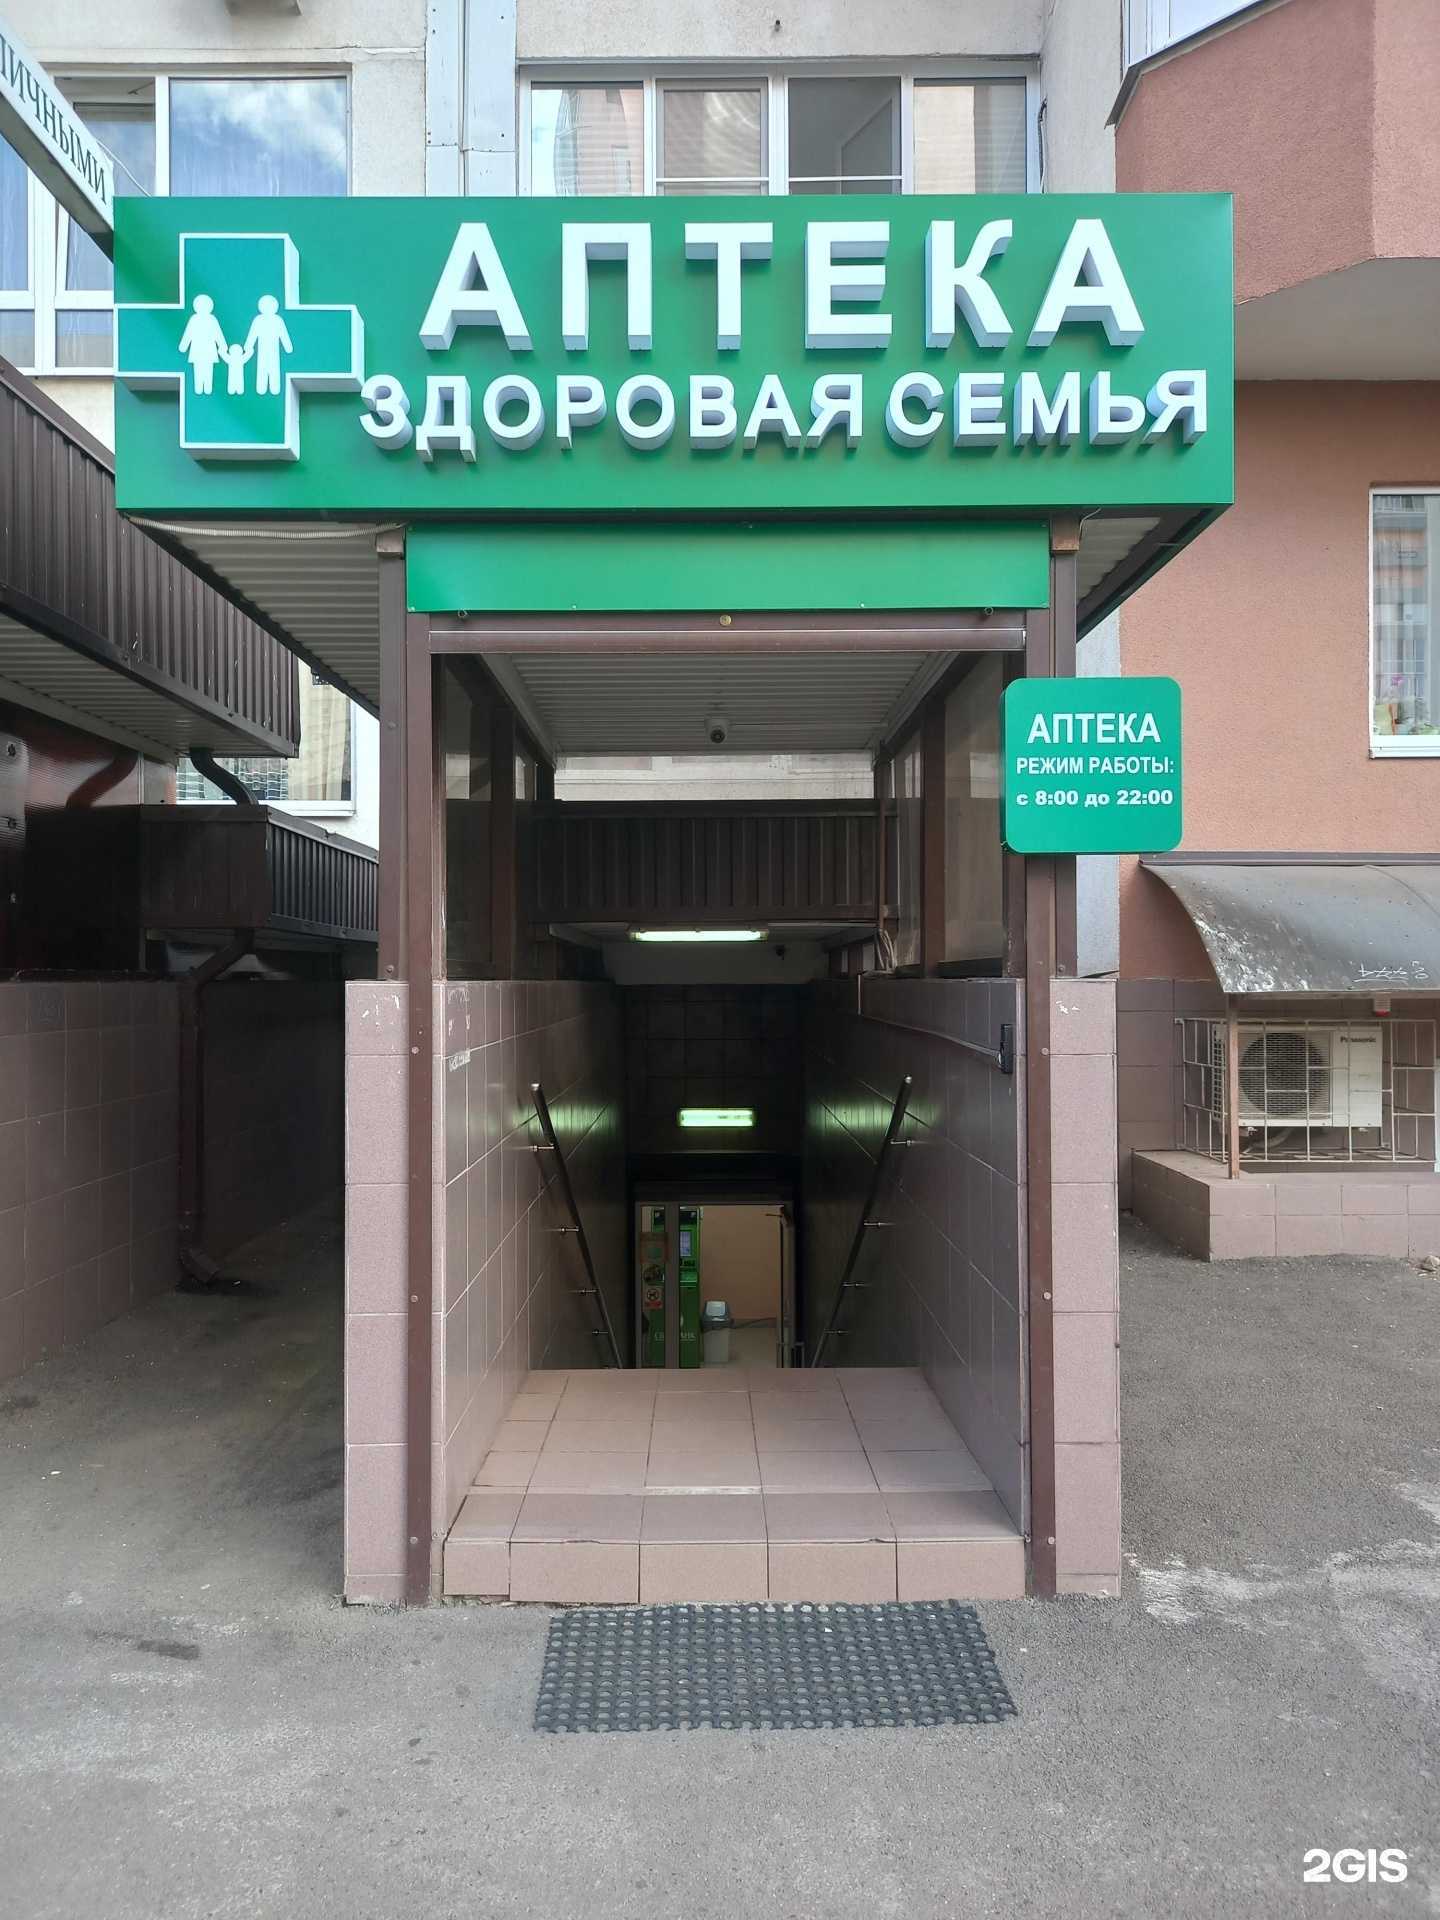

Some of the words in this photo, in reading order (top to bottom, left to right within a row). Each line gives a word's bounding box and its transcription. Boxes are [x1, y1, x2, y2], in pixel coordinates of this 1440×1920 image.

[419, 218, 1145, 351] АПТЕКА
[359, 374, 863, 462] ЗДОРОВАЯ
[886, 369, 1207, 448] СЕМЬЯ
[1027, 712, 1161, 744] АПТЕКА
[1016, 757, 1083, 775] РЕЖИМ
[1089, 756, 1174, 774] РАБОТЫ:
[1035, 790, 1079, 806] 8:00
[1084, 793, 1110, 808] до
[1116, 789, 1173, 805] 22:00
